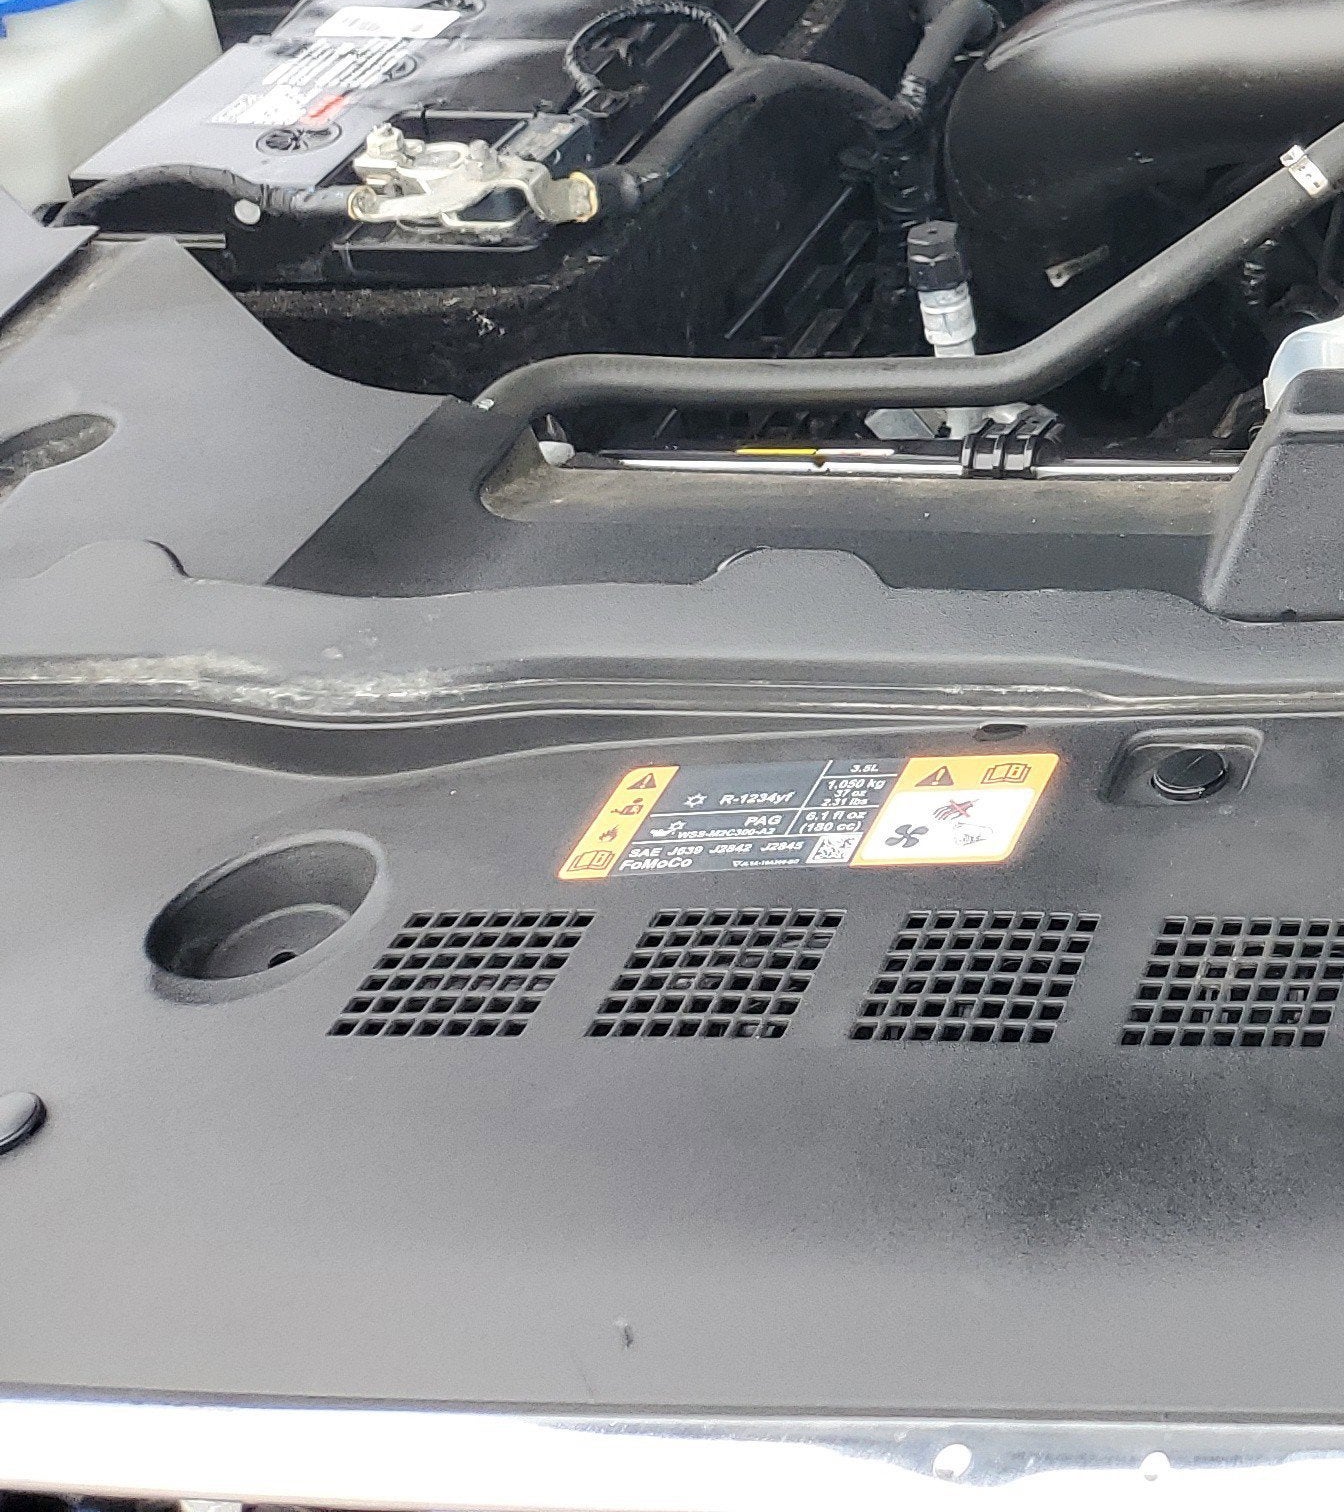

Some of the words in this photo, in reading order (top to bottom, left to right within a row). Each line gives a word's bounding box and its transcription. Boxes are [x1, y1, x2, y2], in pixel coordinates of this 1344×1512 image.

[850, 763, 879, 773] 3.5L
[866, 779, 887, 790] kg
[719, 790, 797, 806] R-1234yf
[833, 789, 851, 798] 37
[820, 797, 848, 807] 2.31
[849, 797, 869, 806] lbs
[743, 814, 783, 827] PAG
[805, 810, 830, 821] 6.1
[846, 811, 868, 820] oz
[799, 821, 834, 834] (180
[836, 820, 862, 832] cc)
[628, 846, 663, 859] SAE
[708, 843, 753, 855] J2842
[760, 840, 805, 853] J2845
[618, 856, 693, 872] FoMoCo
